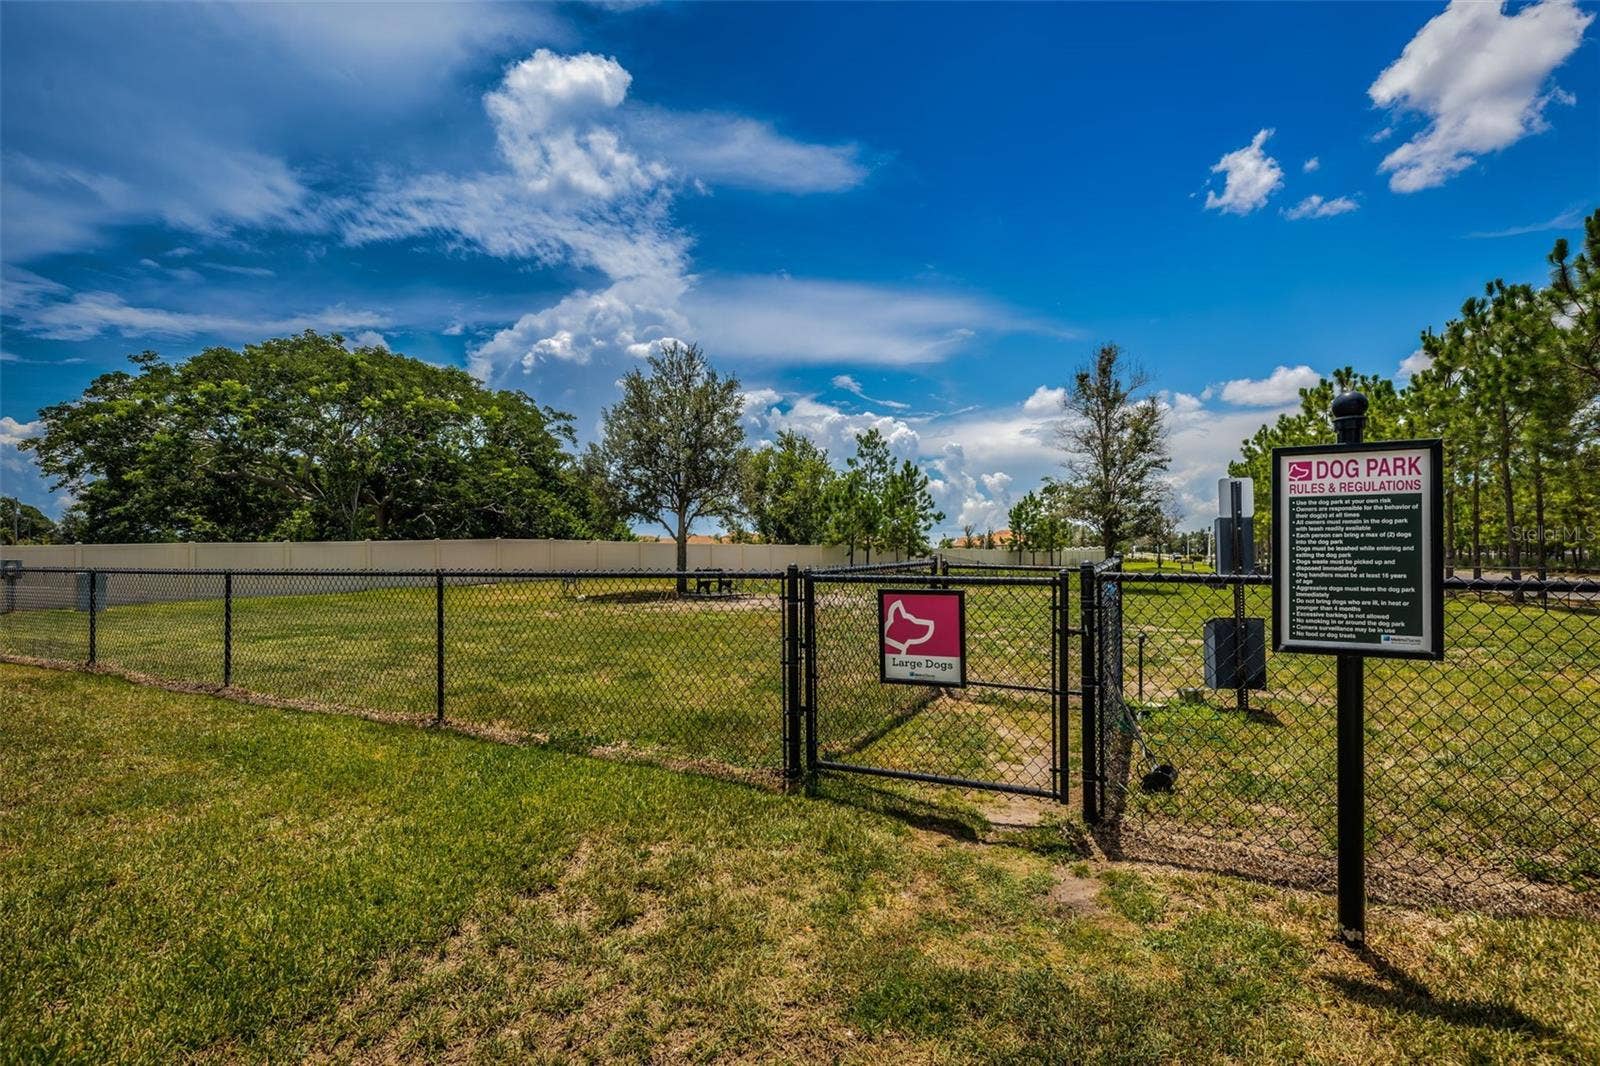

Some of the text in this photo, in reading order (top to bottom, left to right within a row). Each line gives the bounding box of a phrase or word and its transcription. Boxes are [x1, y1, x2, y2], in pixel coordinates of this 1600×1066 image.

[1316, 456, 1422, 480] DOG PARK
[1290, 480, 1421, 494] RULES & REGULATIONS
[892, 658, 954, 672] Large Dogs
